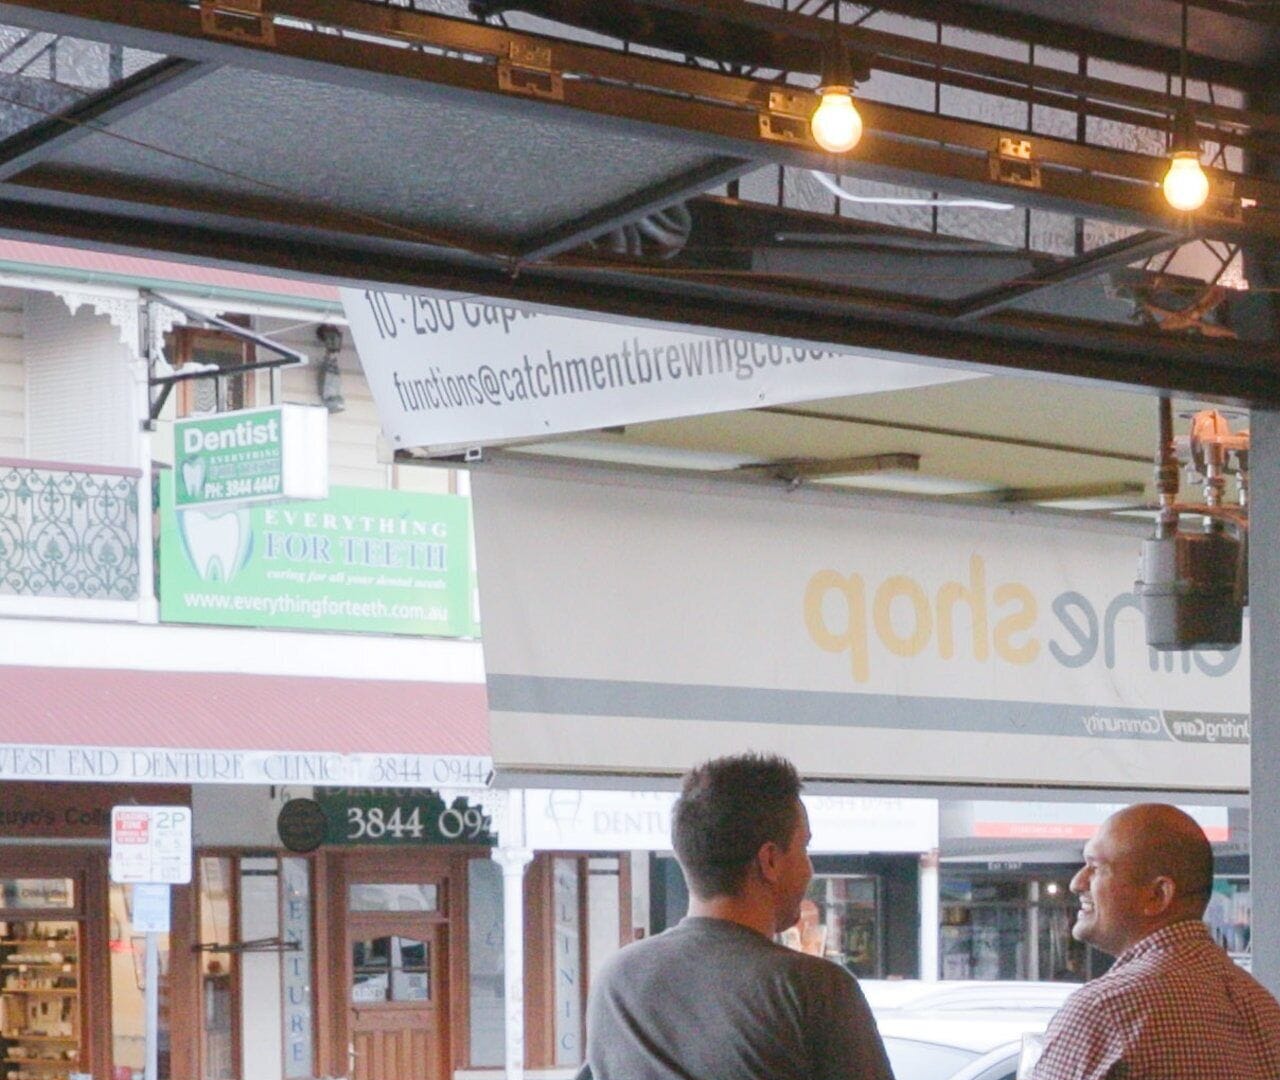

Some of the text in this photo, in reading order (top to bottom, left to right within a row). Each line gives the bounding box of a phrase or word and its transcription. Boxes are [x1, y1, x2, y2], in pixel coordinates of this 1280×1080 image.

[393, 337, 846, 412] functions@catchmentbrewingco.
[184, 419, 279, 453] Dentist
[264, 510, 448, 538] EVERYTHING
[263, 530, 448, 573] FOR TEETH
[307, 569, 325, 584] for
[183, 593, 448, 622] www.everythingforteeth.com.au
[69, 750, 119, 777] END
[132, 751, 245, 780] DENTURE
[263, 754, 343, 781] CLINIC
[373, 758, 422, 783] 3844
[432, 759, 484, 784] 0944
[156, 811, 185, 829] 2P
[347, 807, 424, 839] 3844
[592, 810, 671, 835] DENTU
[288, 880, 304, 1062] ENTURE
